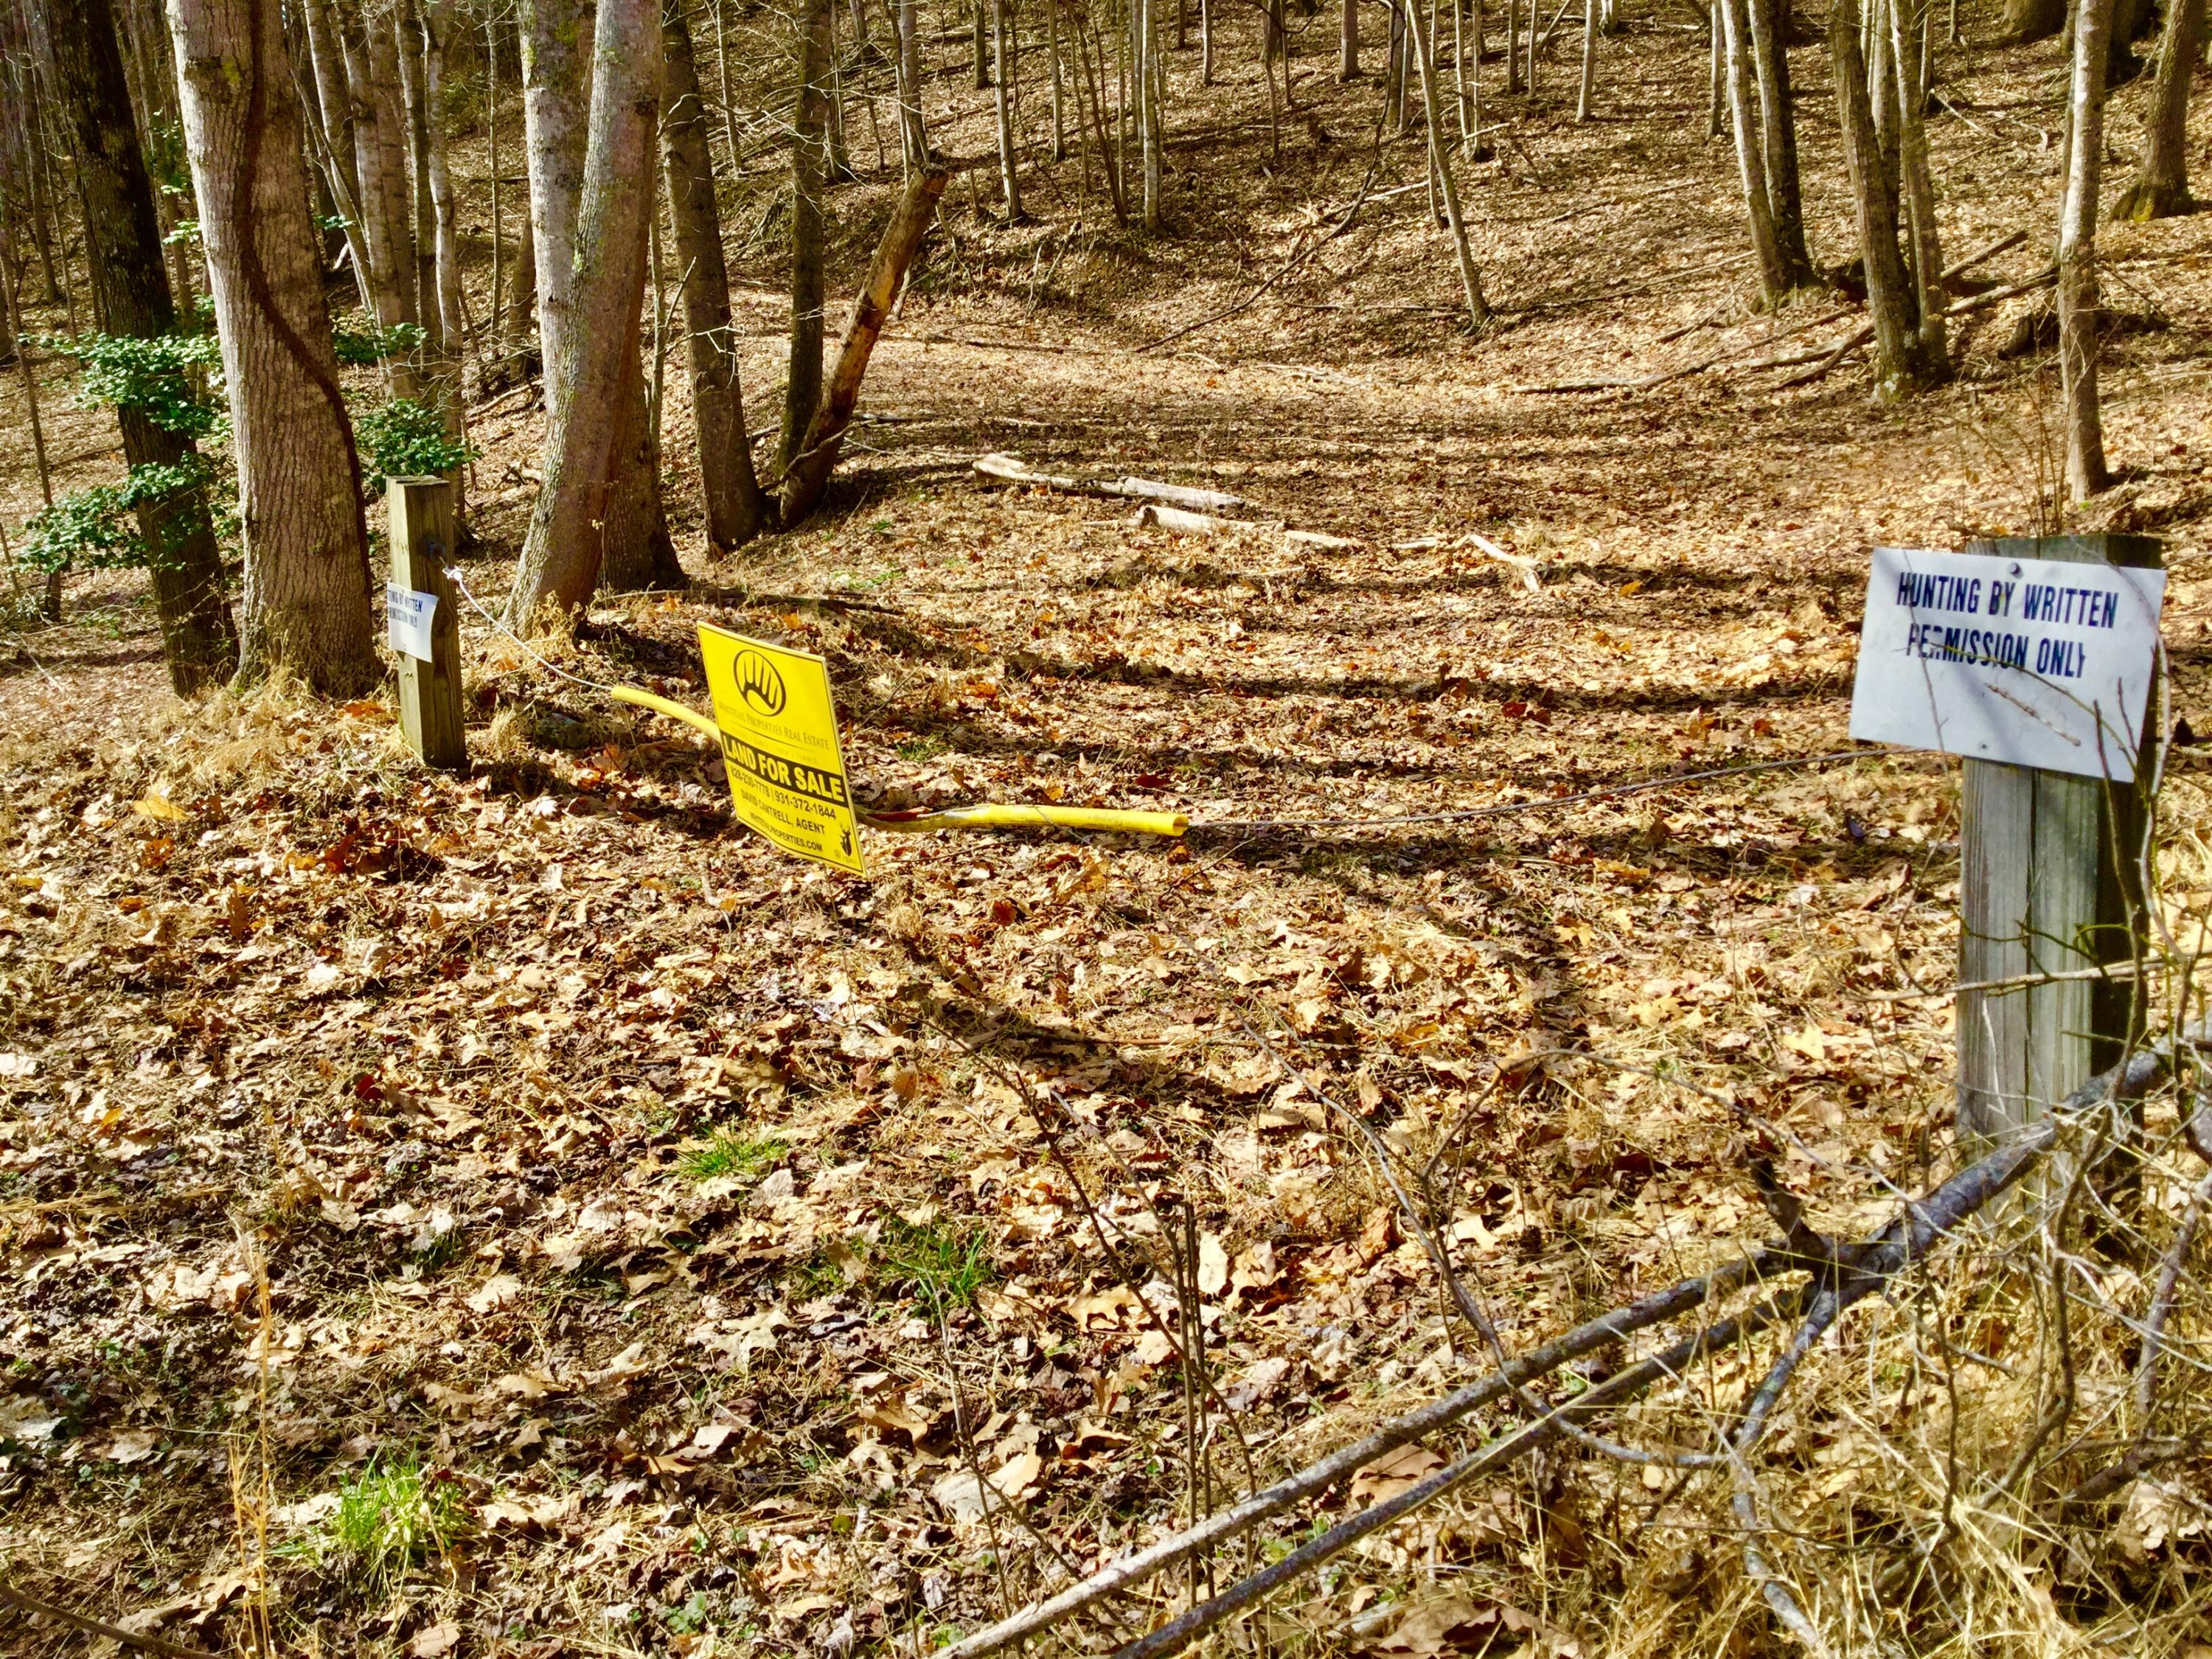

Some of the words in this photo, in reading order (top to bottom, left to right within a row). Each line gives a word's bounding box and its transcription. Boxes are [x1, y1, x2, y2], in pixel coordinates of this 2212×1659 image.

[1896, 571, 1982, 614] HUNTING
[1989, 580, 2017, 616] BY
[2023, 583, 2119, 629] WRITTEN
[1906, 622, 2029, 669] PERMISSION
[2037, 637, 2086, 678] ONLY
[746, 713, 782, 736] PROPERTIES
[784, 726, 803, 742] REAL
[803, 732, 830, 750] ESTATE
[723, 734, 757, 771] LAND
[757, 753, 792, 786] FOR
[794, 767, 845, 802] SALE
[774, 790, 837, 820] 931-372-1844
[796, 817, 825, 835] AGENT
